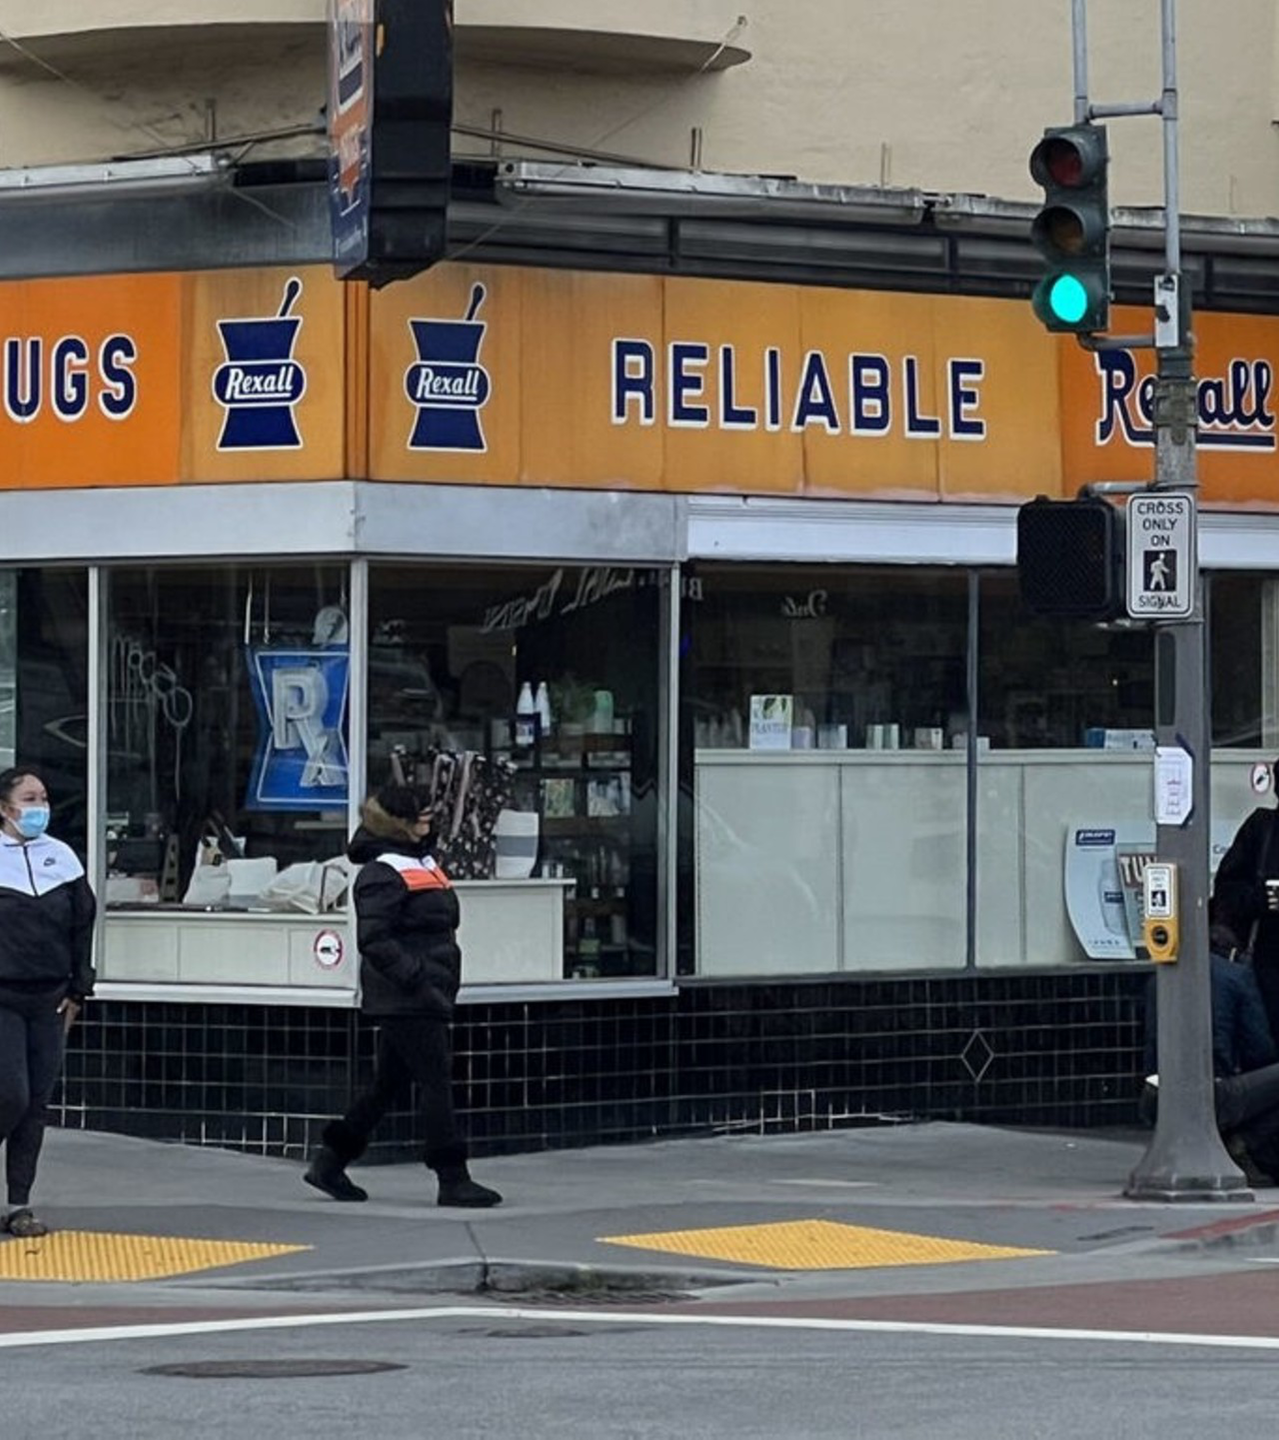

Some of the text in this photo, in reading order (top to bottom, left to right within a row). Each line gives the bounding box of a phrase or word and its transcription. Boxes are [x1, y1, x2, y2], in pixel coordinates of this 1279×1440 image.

[225, 364, 294, 400] Rexall
[415, 367, 480, 402] Rexall
[611, 338, 987, 441] RELIABLE
[1094, 348, 1276, 452] Reall
[1137, 502, 1184, 515] CROSS
[1142, 518, 1178, 531] ONLY
[1150, 534, 1171, 547] ON
[1138, 594, 1182, 608] SIGNAL
